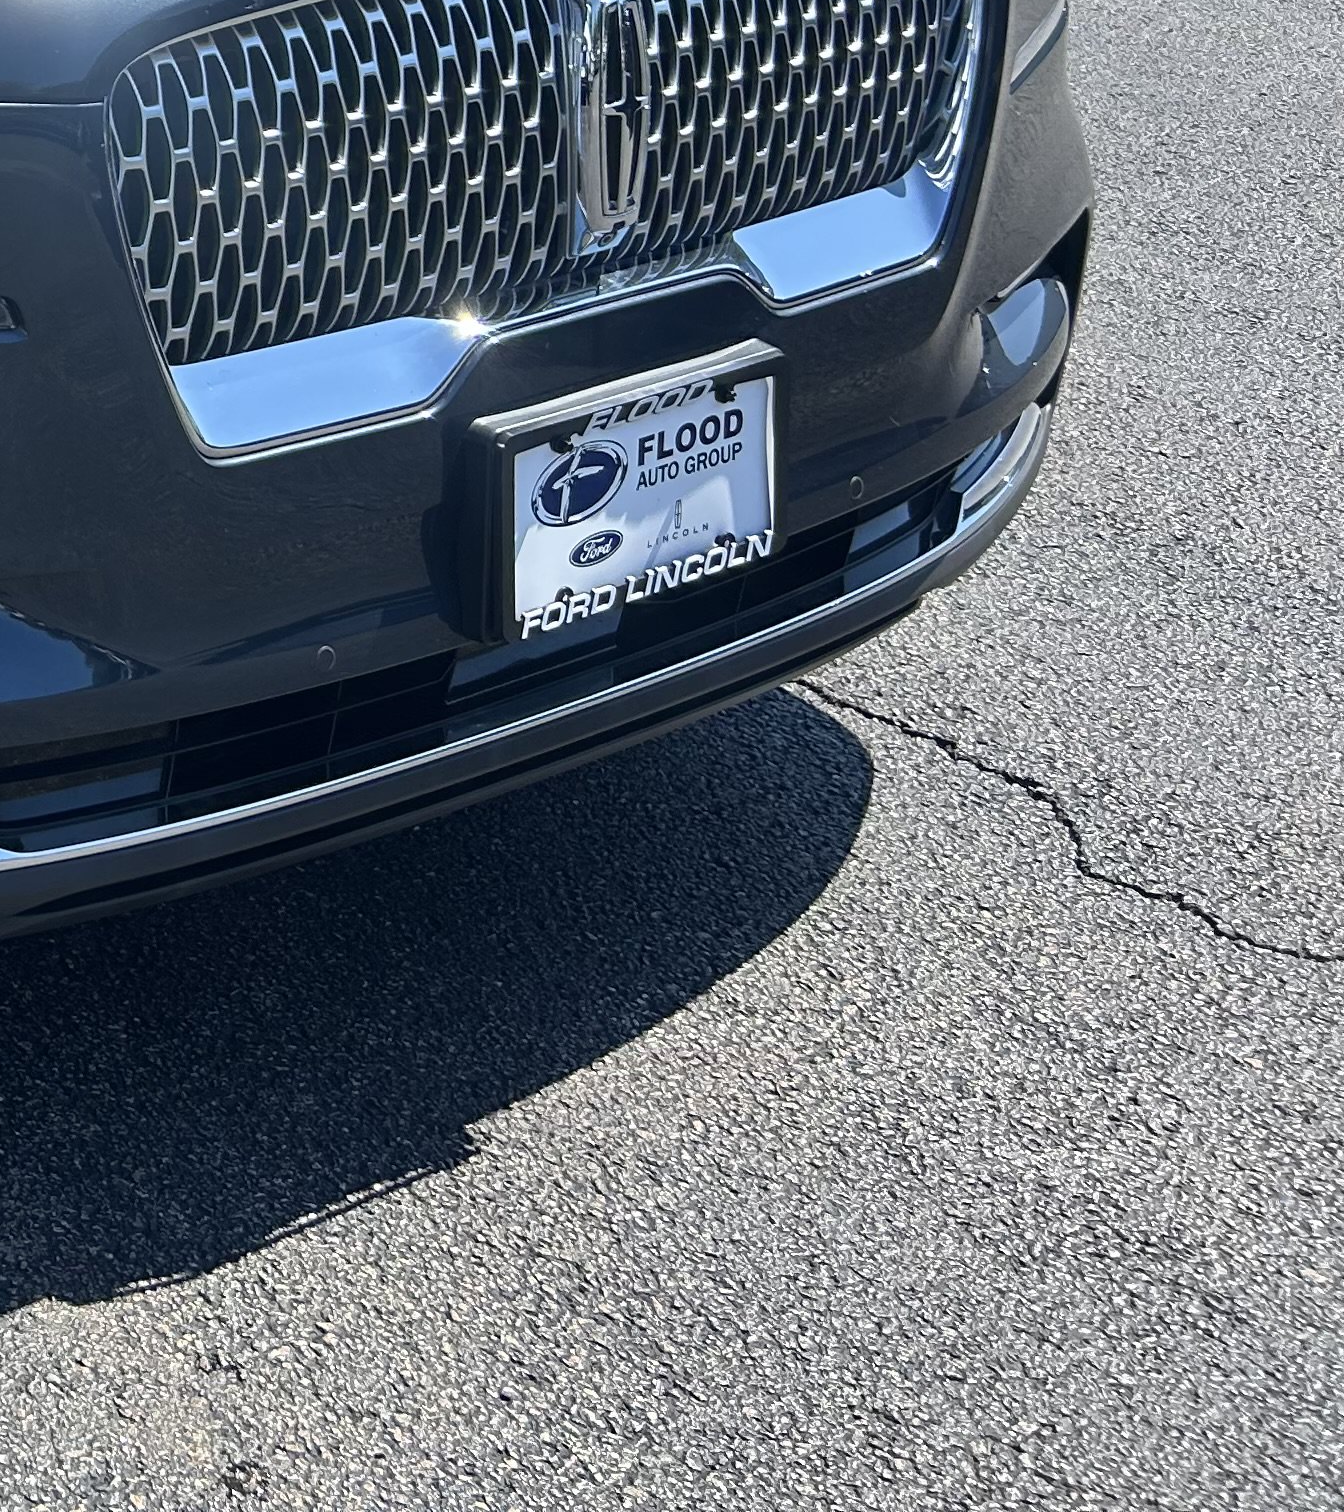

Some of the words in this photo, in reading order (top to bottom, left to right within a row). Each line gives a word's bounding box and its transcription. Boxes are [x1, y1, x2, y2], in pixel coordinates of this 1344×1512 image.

[582, 378, 714, 437] FLOOD
[638, 408, 744, 467] FLOOD
[636, 460, 679, 491] AUTO
[684, 442, 743, 475] GROUP
[579, 536, 614, 562] Ford
[647, 522, 709, 548] LINCOLN
[520, 584, 617, 640] FORD
[624, 529, 773, 603] LINCOLN
